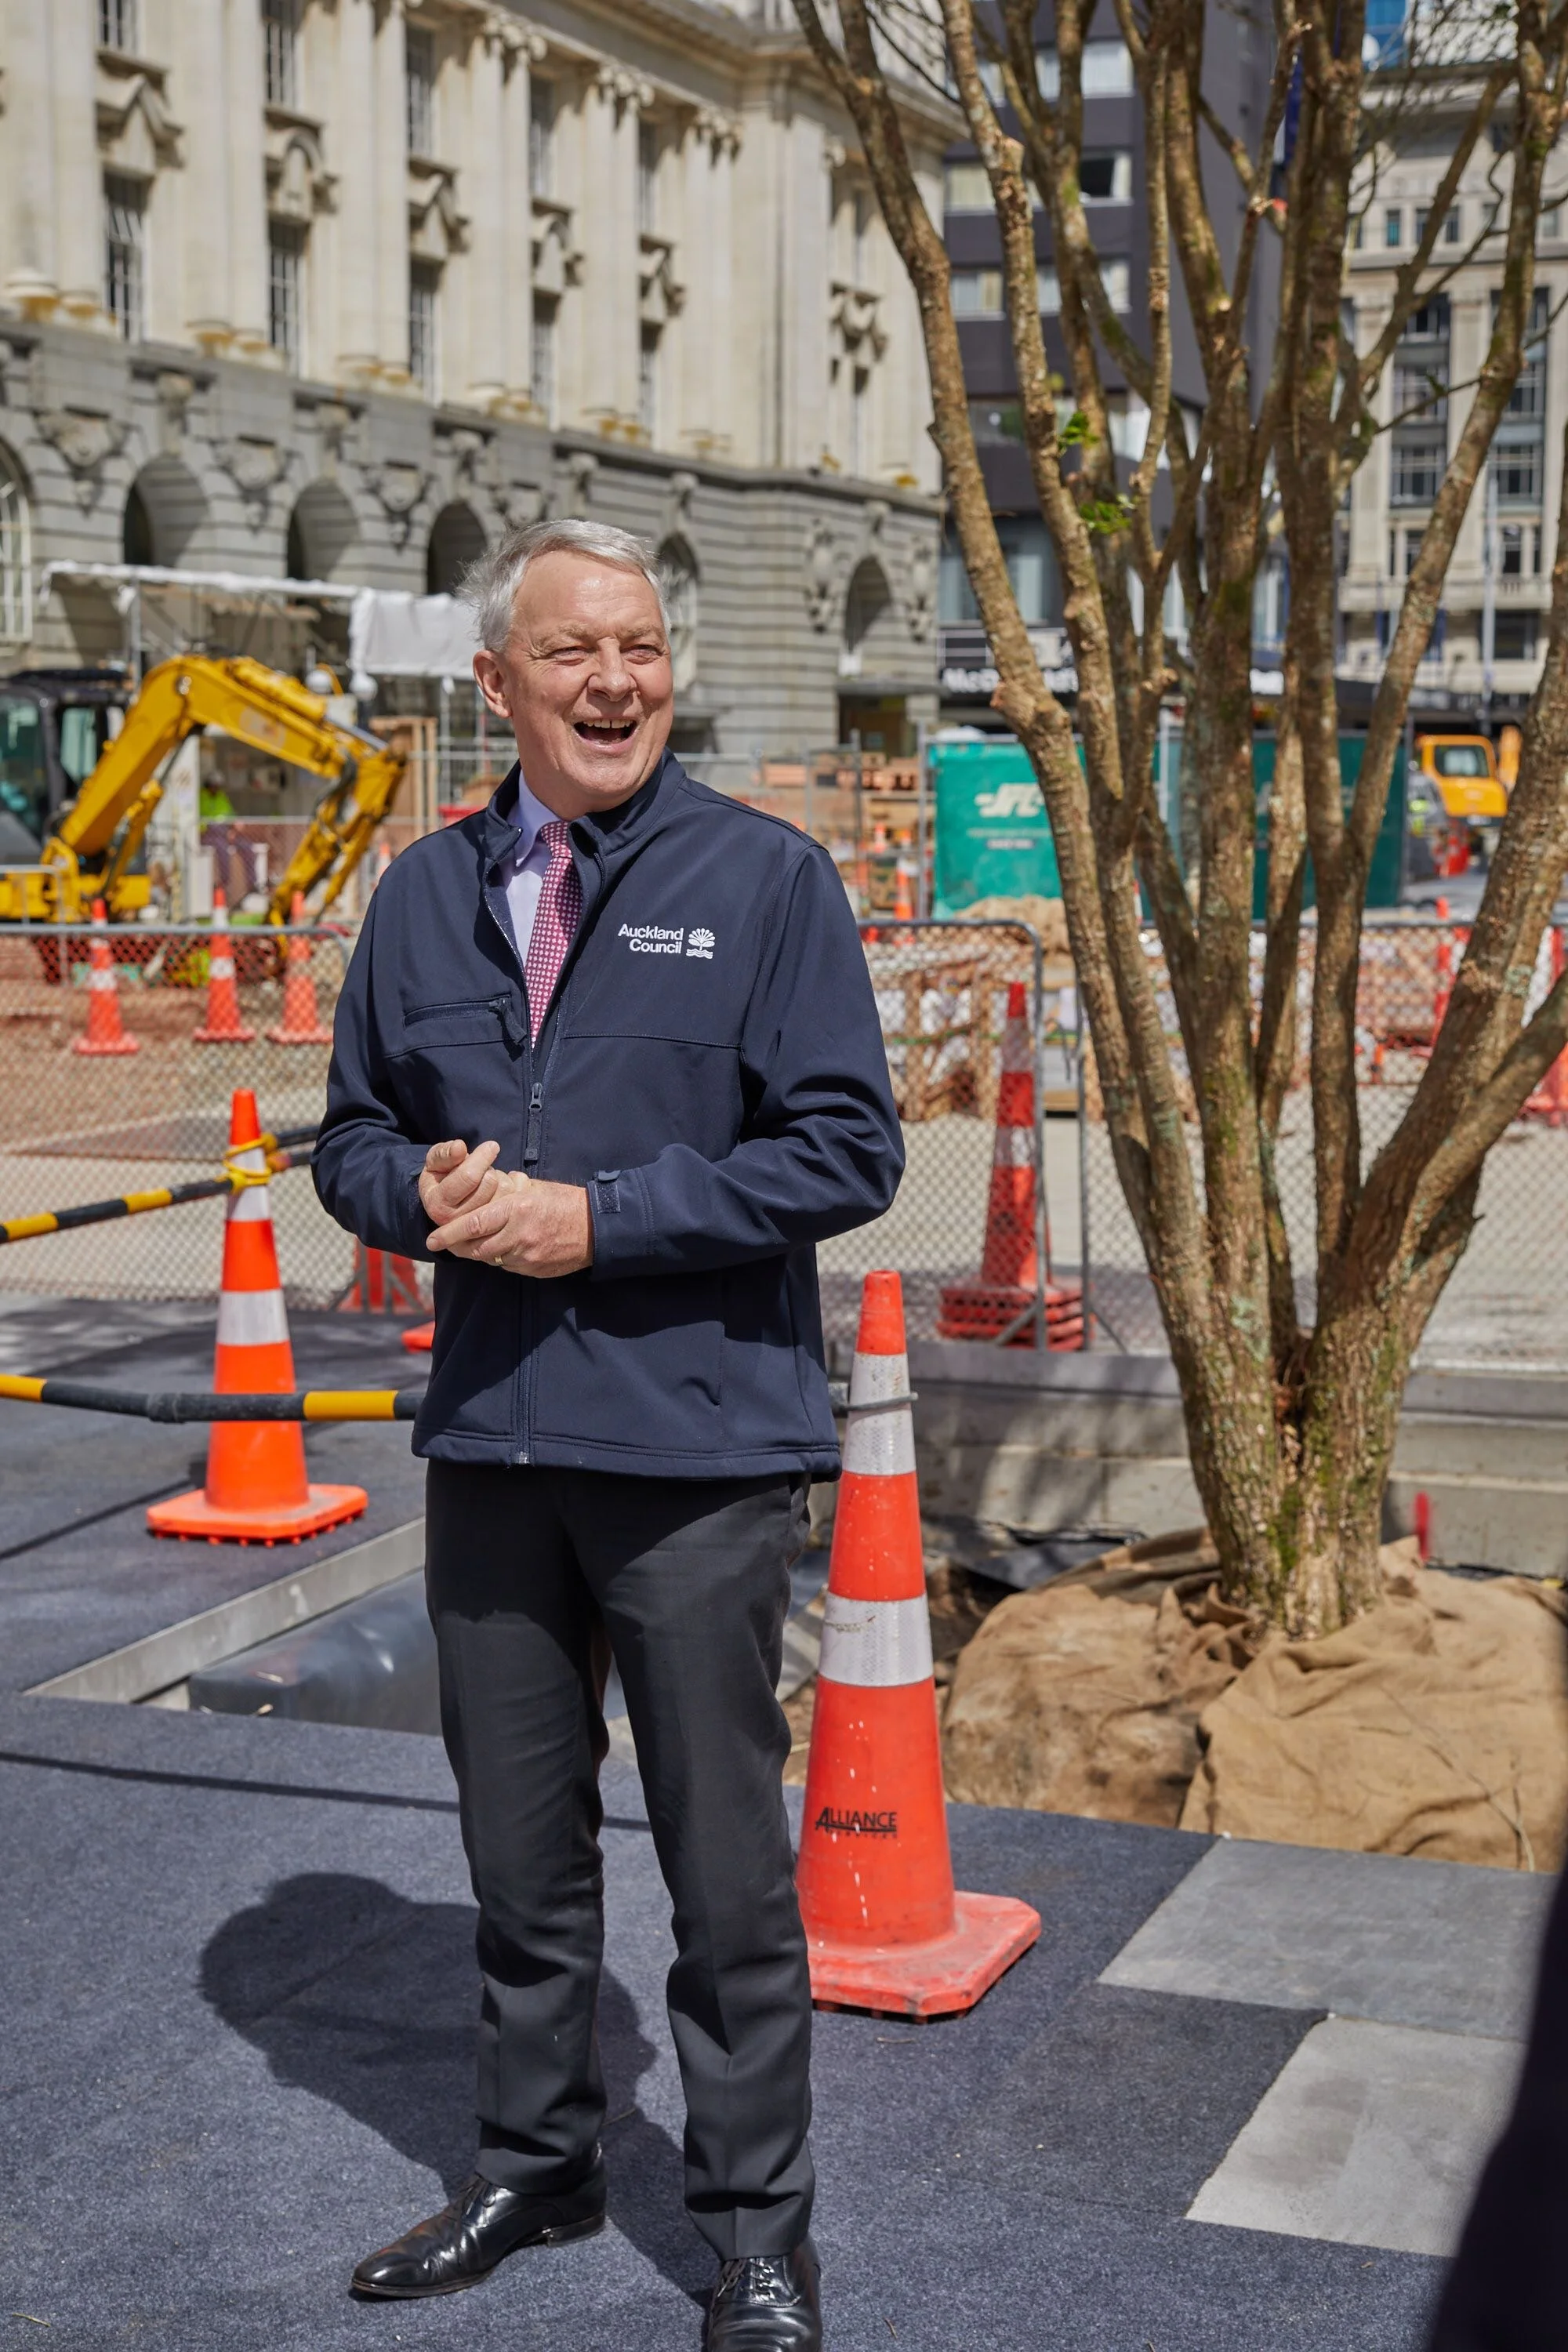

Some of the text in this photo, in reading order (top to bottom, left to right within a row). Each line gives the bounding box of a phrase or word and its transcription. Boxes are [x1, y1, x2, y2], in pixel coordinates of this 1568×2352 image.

[618, 924, 684, 941] Auckland
[630, 938, 682, 954] Council
[815, 1806, 898, 1832] ALLIANCE
